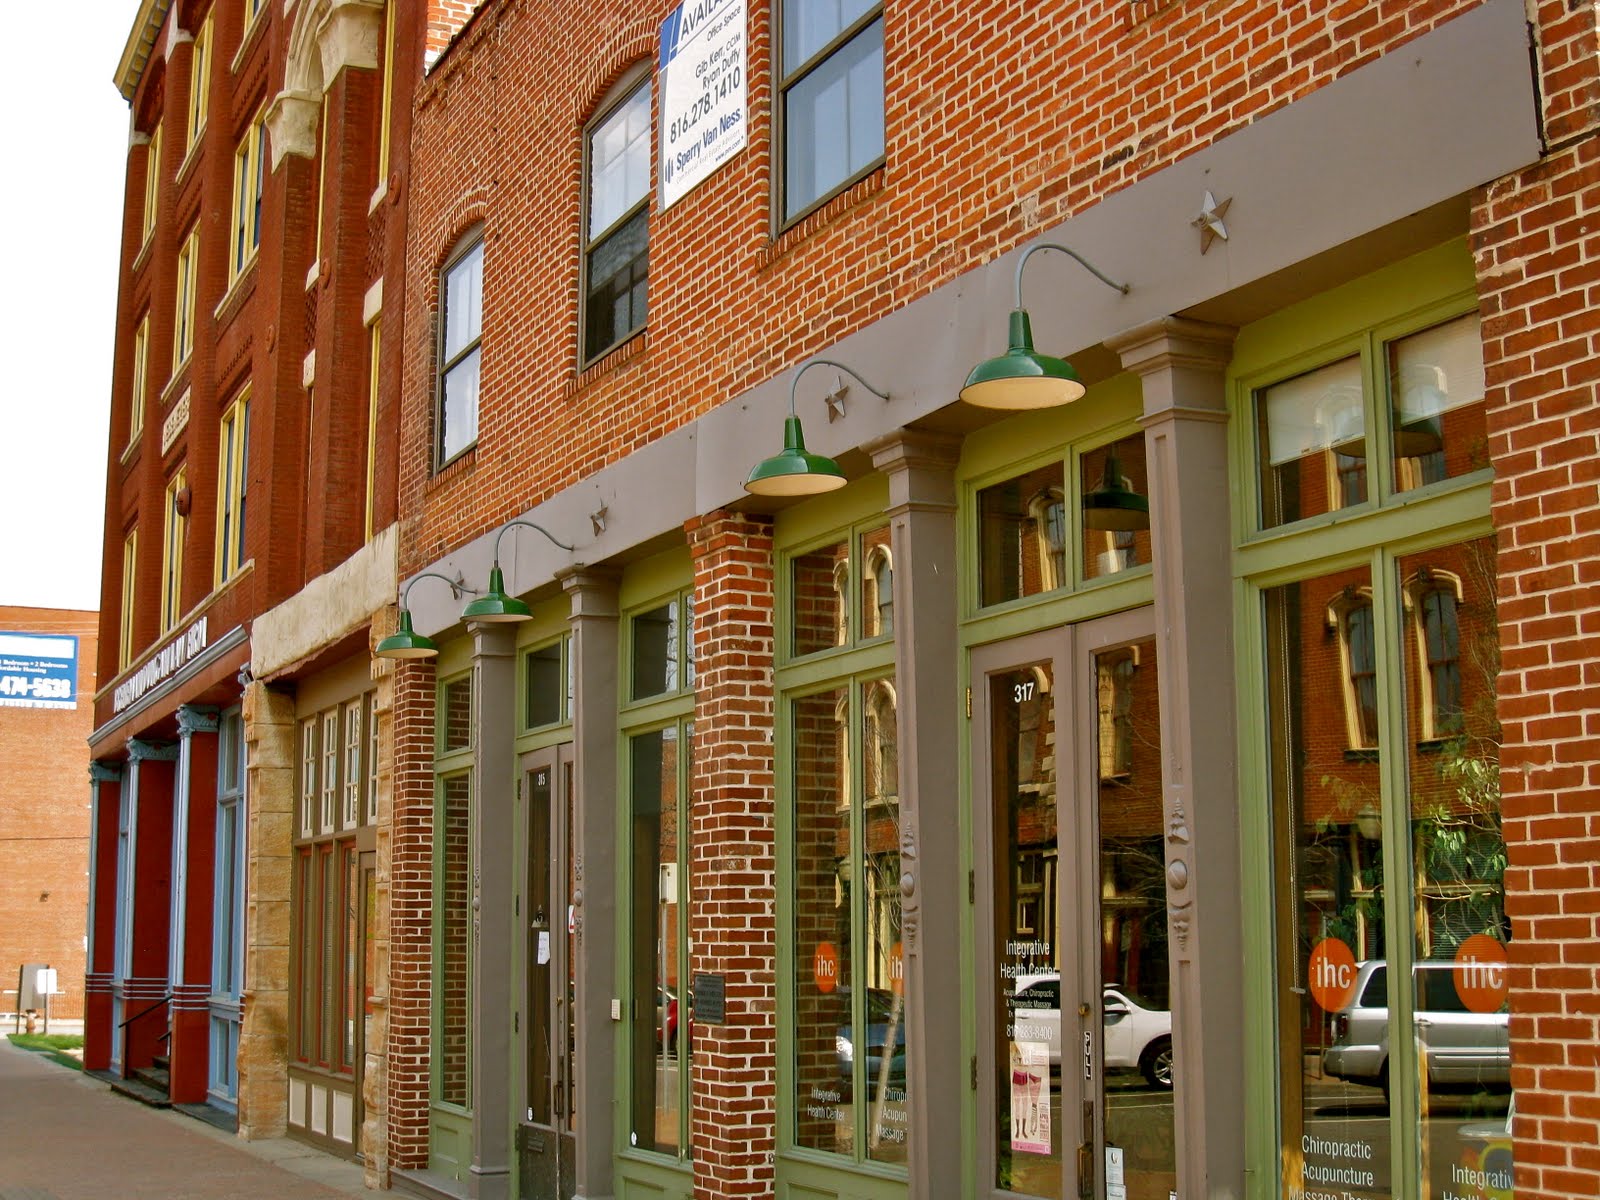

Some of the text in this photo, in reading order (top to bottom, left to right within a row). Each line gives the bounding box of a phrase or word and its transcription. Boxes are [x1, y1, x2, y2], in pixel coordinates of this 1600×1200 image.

[707, 5, 741, 42] Office Space
[695, 60, 708, 78] Gib
[709, 46, 725, 67] Kerr,
[702, 48, 741, 90] Ryan Duffy
[670, 66, 741, 144] 816.278.1410
[676, 140, 701, 172] Sperry
[702, 127, 718, 148] Van
[1014, 681, 1035, 703] 317
[1005, 939, 1050, 959] Integrative
[817, 954, 834, 977] ihc
[1000, 962, 1056, 979] Health Center
[1316, 957, 1350, 988] ihc
[1463, 955, 1503, 990] ihc
[1006, 999, 1052, 1009] & Therapeutic Massage
[1029, 989, 1054, 998] Chiropractic
[1084, 1032, 1092, 1078] PULL
[811, 1087, 841, 1103] Integrative
[807, 1104, 845, 1121] Health Center
[875, 1124, 904, 1143] Massage
[1301, 1134, 1371, 1160] Chiropractic
[1301, 1161, 1374, 1187] Acupuncture
